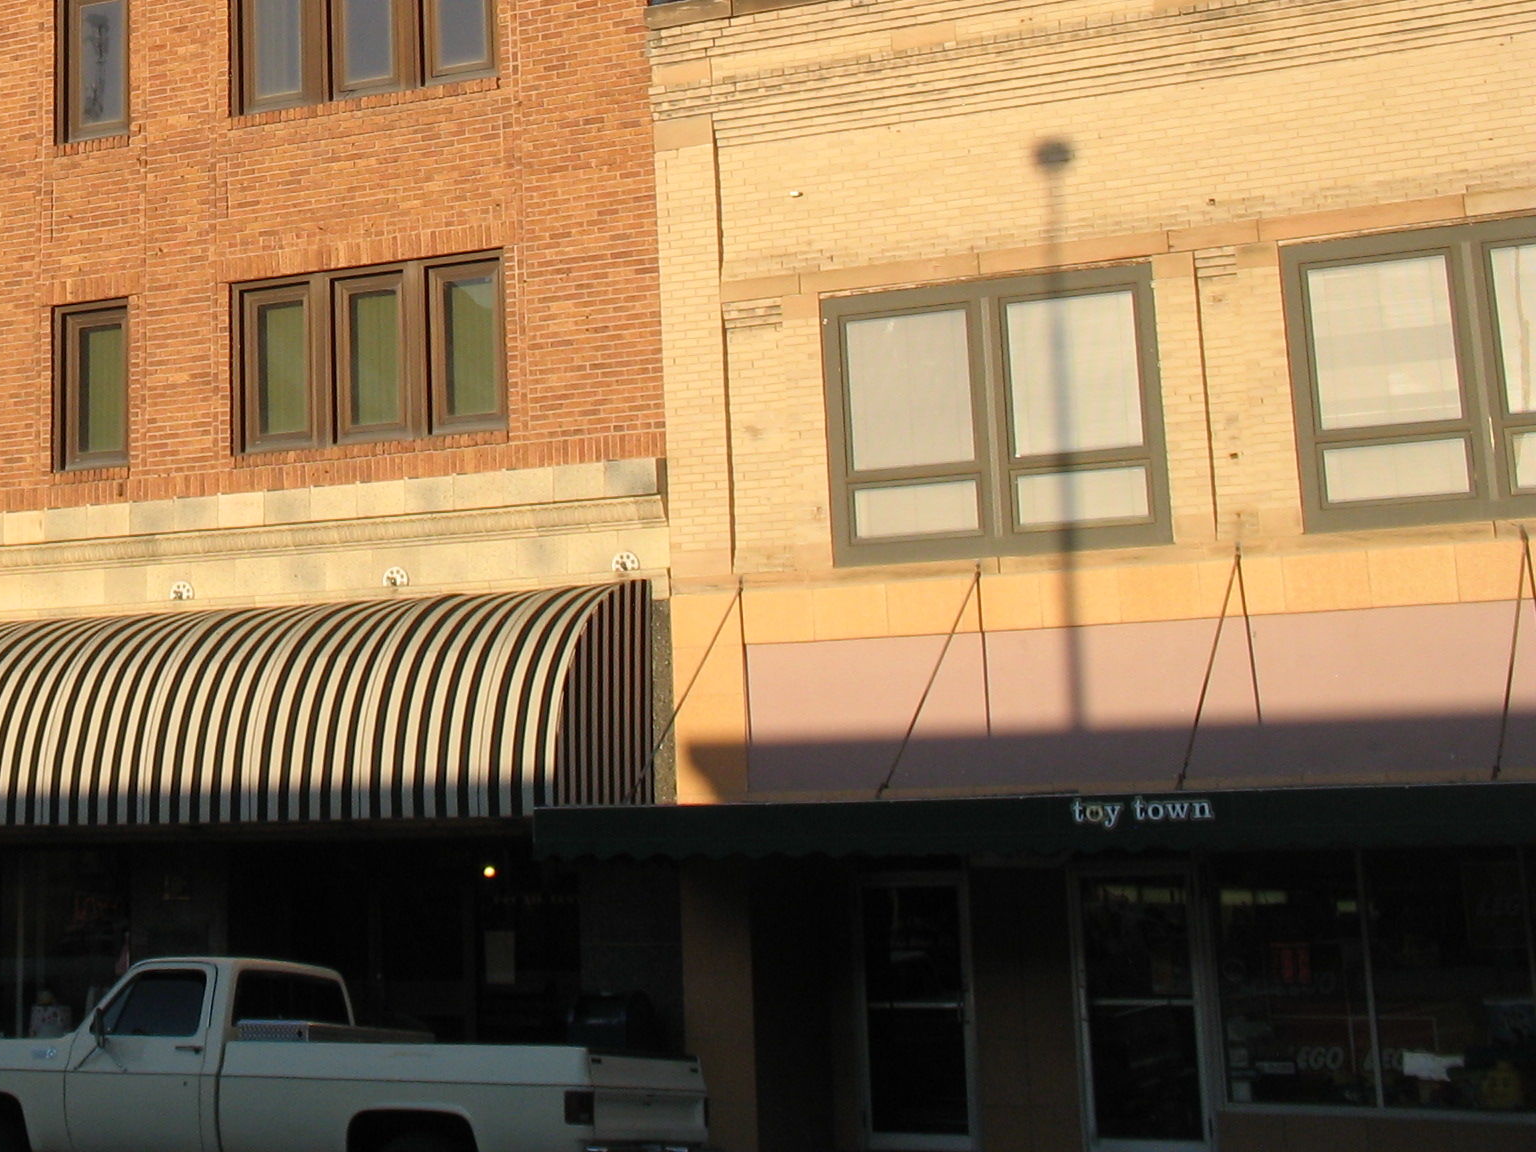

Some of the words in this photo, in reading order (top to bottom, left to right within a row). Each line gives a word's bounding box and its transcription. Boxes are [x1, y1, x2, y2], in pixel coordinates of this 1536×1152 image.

[1071, 798, 1123, 828] toy
[1132, 797, 1215, 821] town
[1290, 1045, 1344, 1071] EGO
